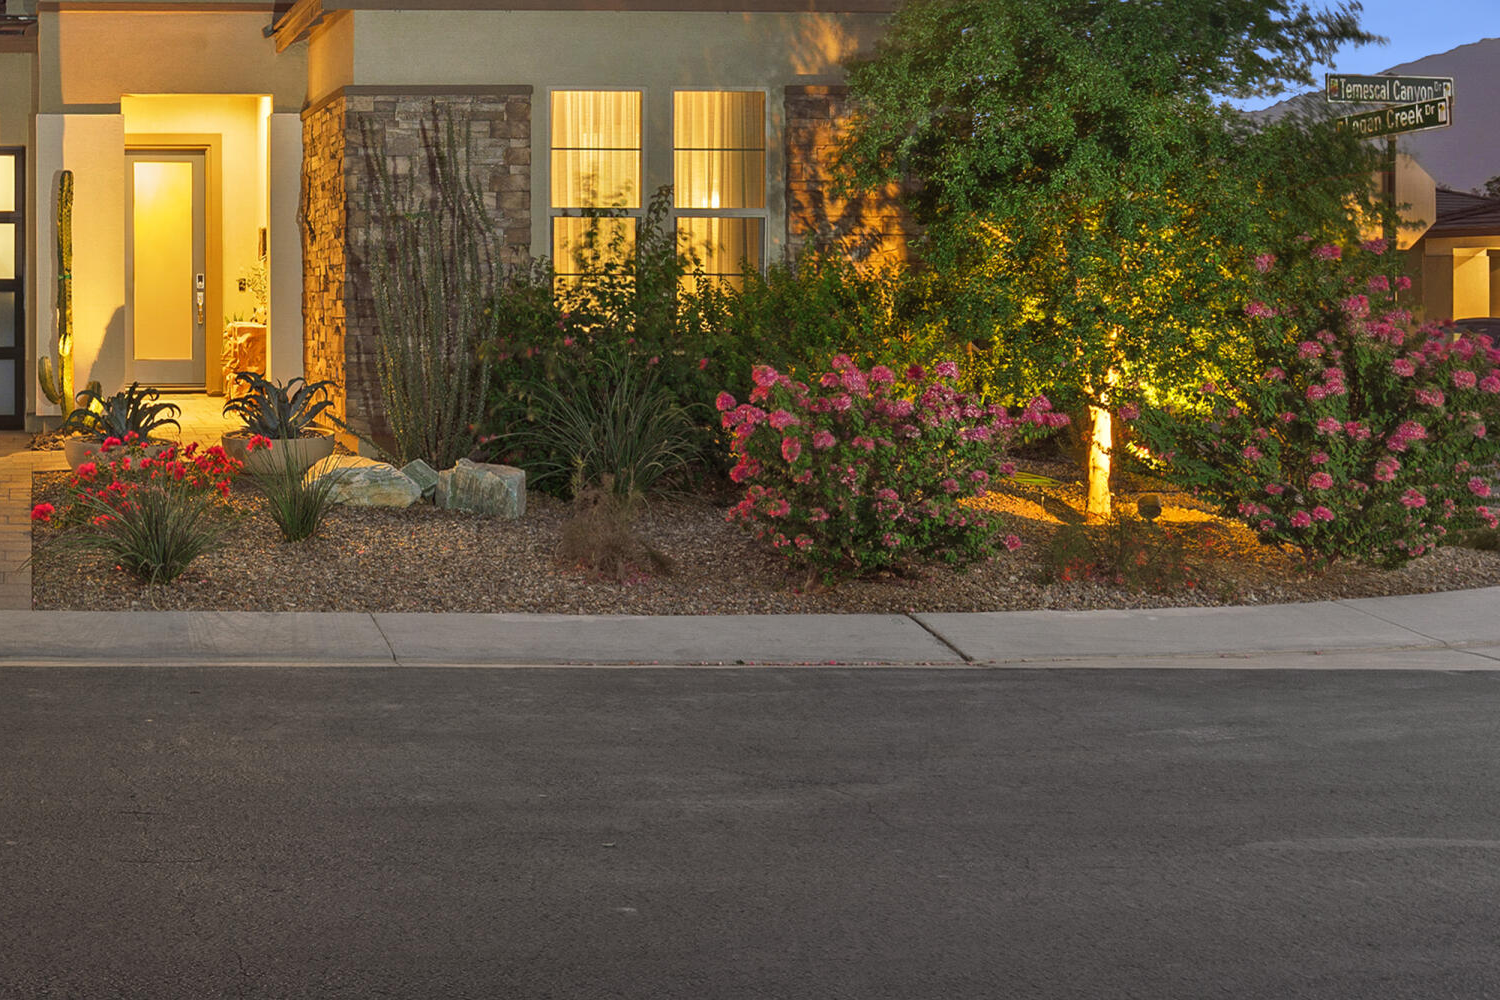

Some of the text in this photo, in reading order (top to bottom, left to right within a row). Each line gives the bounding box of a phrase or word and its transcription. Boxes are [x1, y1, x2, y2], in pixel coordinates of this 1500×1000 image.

[1340, 78, 1442, 103] Temescal Canyon Dr
[1386, 104, 1424, 128] Creek
[1425, 104, 1435, 116] Dr
